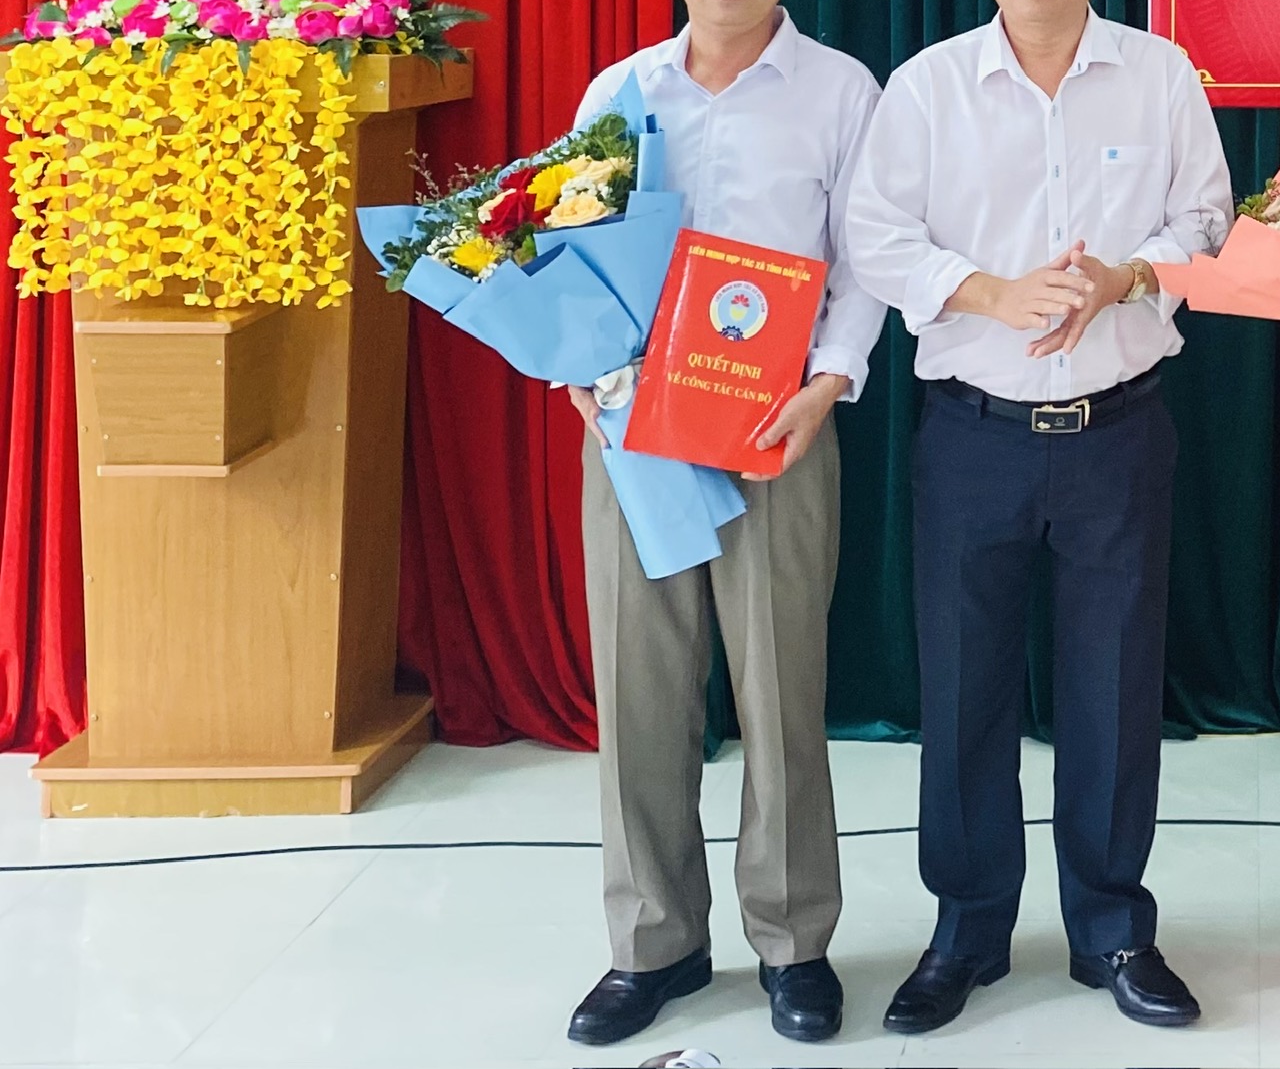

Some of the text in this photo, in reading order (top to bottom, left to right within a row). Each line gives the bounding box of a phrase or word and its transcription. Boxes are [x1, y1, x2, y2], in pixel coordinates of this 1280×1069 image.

[741, 257, 755, 268] TÁC
[688, 353, 731, 373] QUYẾT
[682, 375, 712, 391] CÔNG
[713, 382, 734, 395] TÁC
[735, 387, 756, 400] CÁN
[757, 392, 772, 406] BỘ
